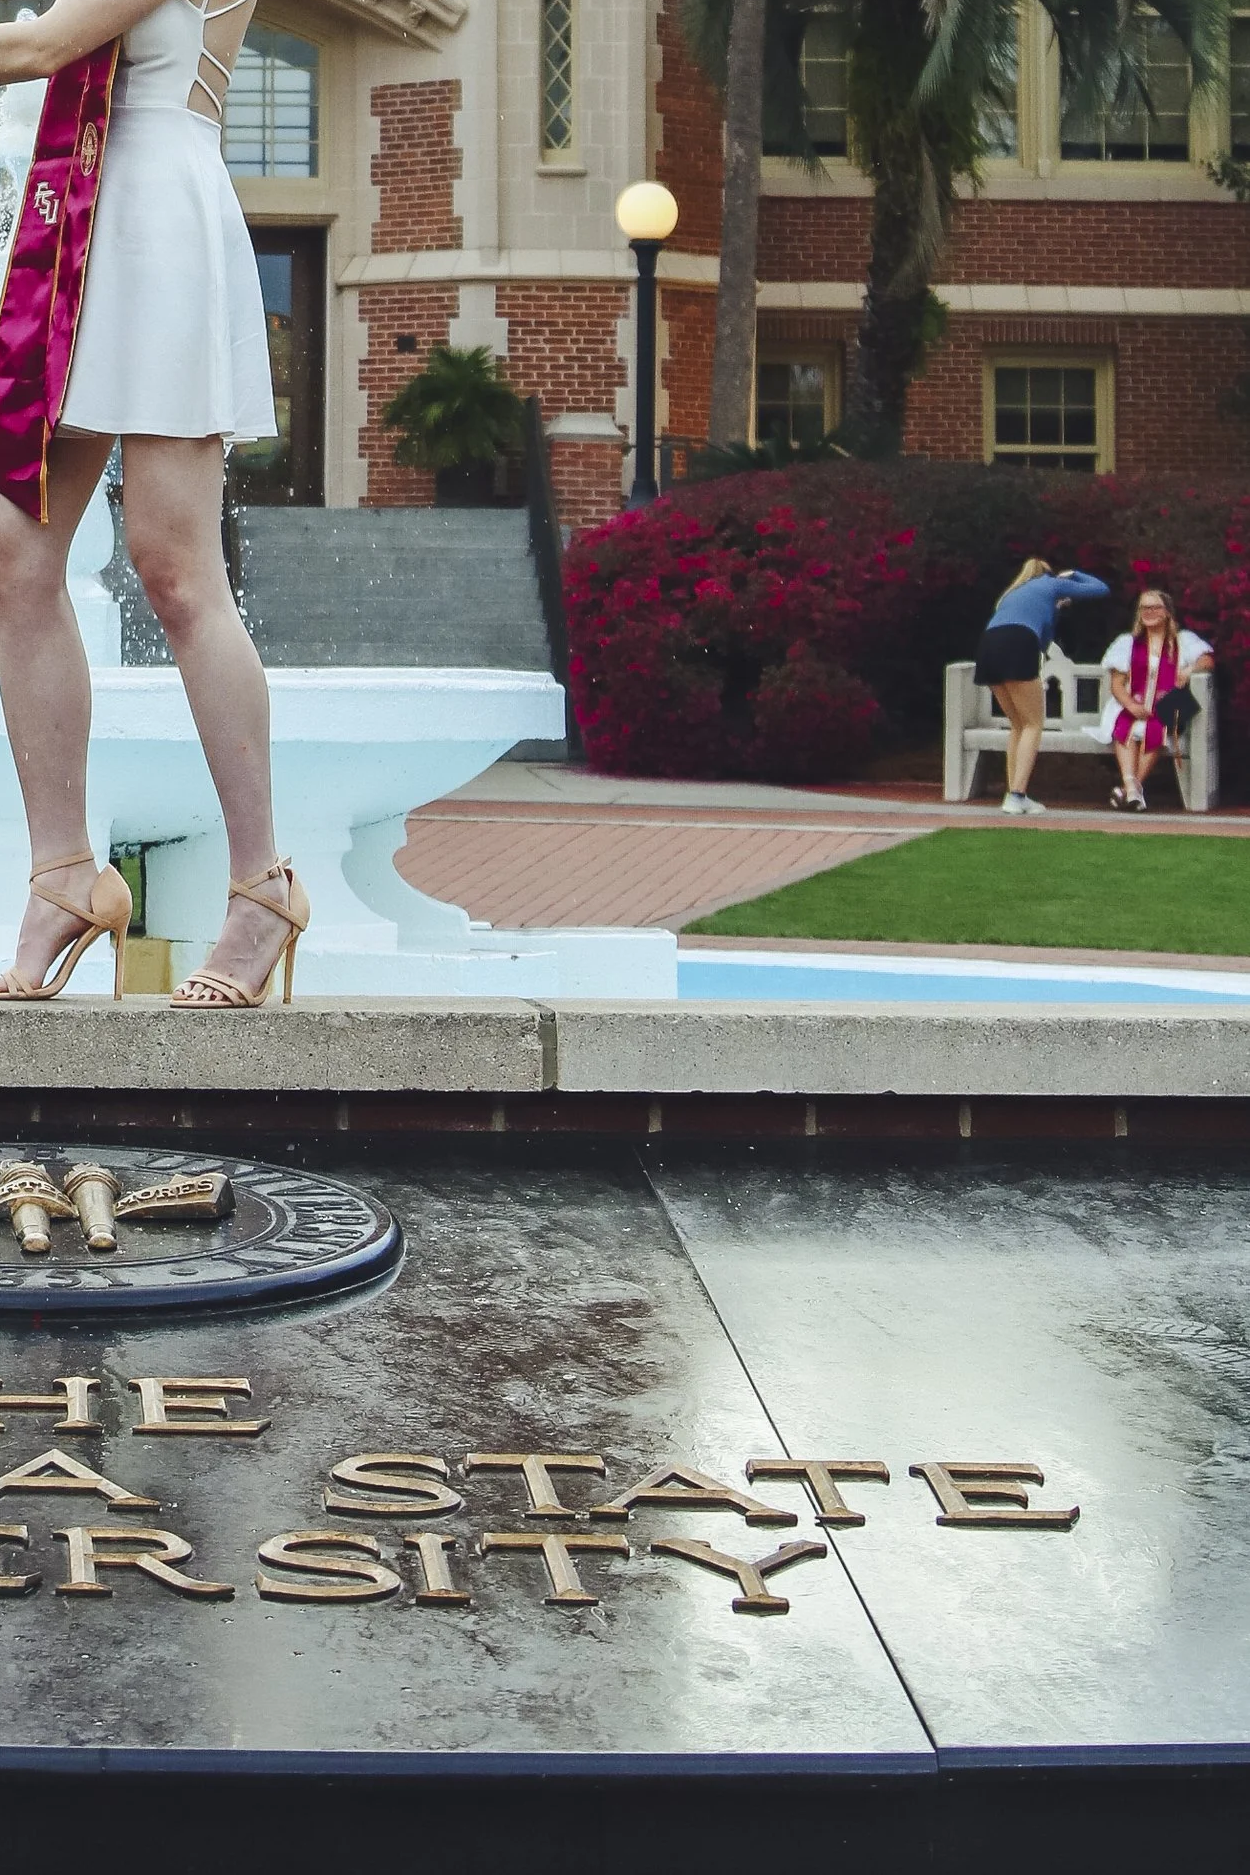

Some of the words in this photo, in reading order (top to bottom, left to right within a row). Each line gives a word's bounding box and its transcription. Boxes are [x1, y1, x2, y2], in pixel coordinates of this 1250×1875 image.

[33, 181, 60, 224] FSU
[114, 1178, 214, 1210] MORES
[134, 1153, 370, 1275] UNIVERSITY
[322, 1451, 1080, 1527] STATE
